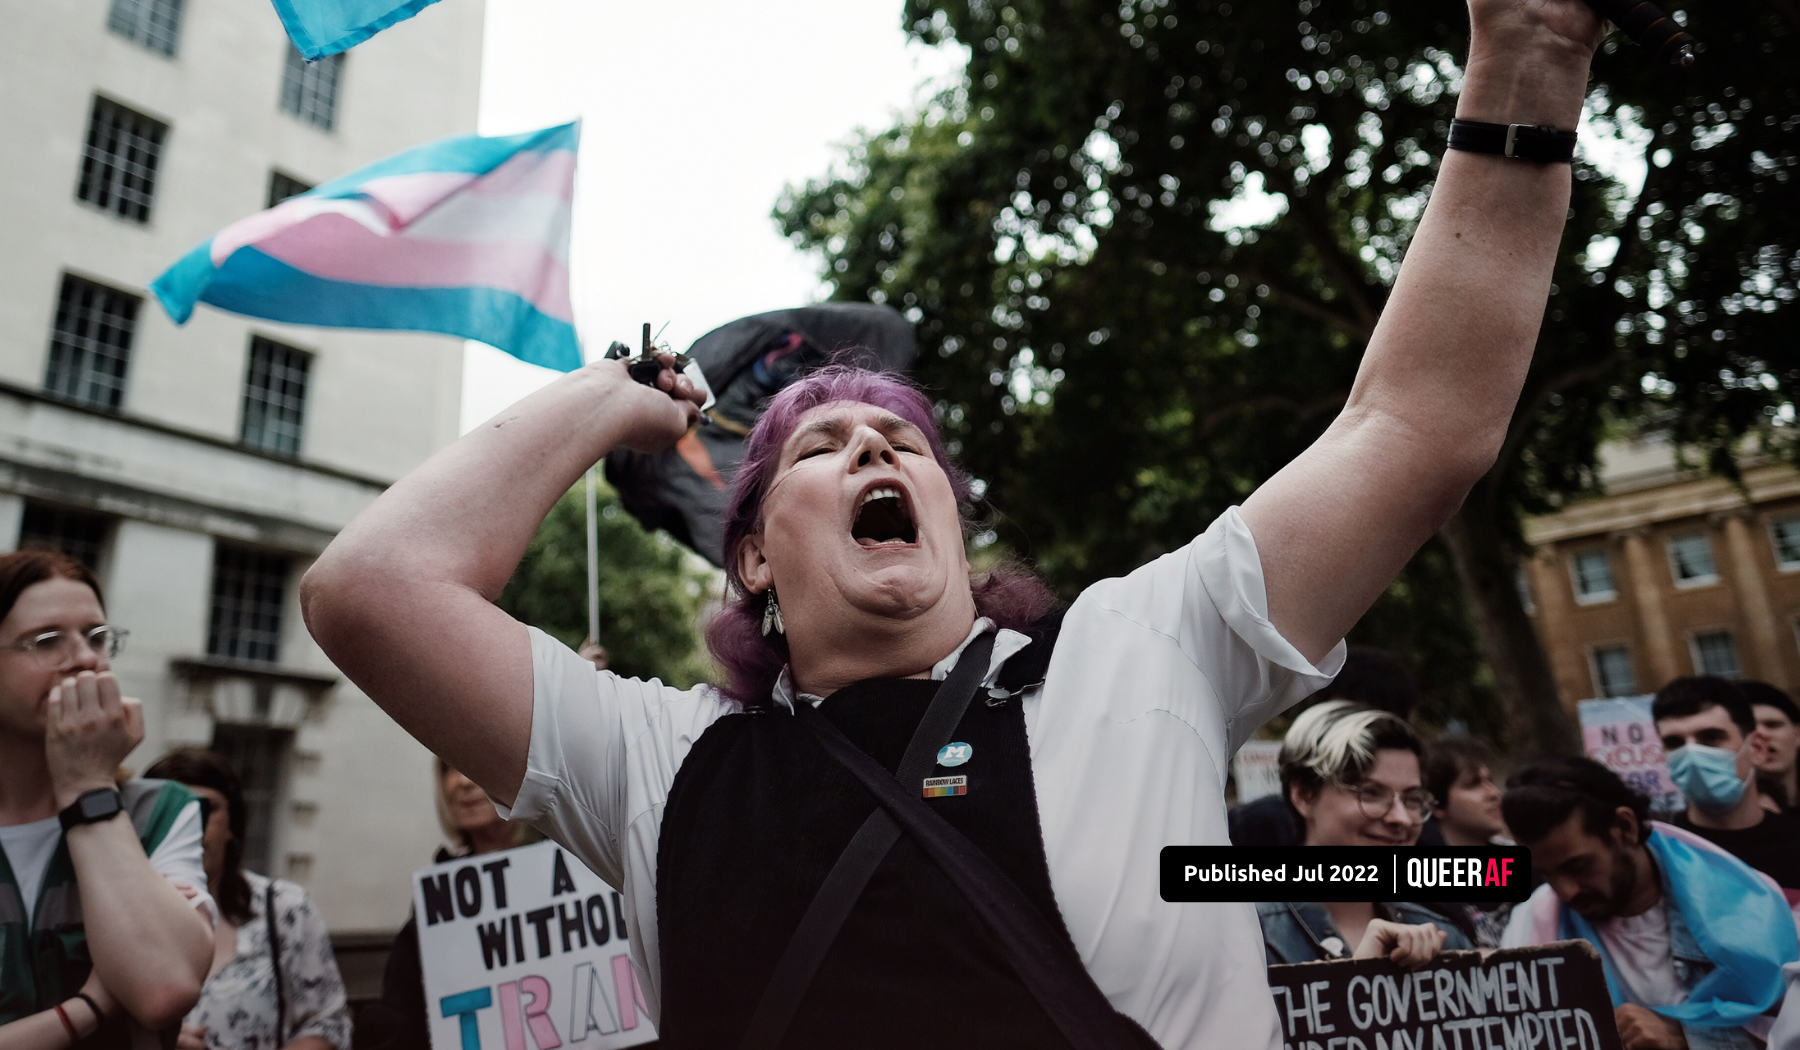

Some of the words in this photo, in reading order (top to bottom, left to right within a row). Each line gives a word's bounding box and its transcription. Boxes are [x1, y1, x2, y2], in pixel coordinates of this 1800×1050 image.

[1601, 723, 1644, 746] NO
[925, 778, 949, 787] RAINBOW
[949, 777, 964, 785] LACES
[421, 857, 511, 926] NOT
[552, 849, 576, 896] A
[1270, 980, 1336, 1037] HE
[1347, 957, 1565, 1030] GOVERNMENT
